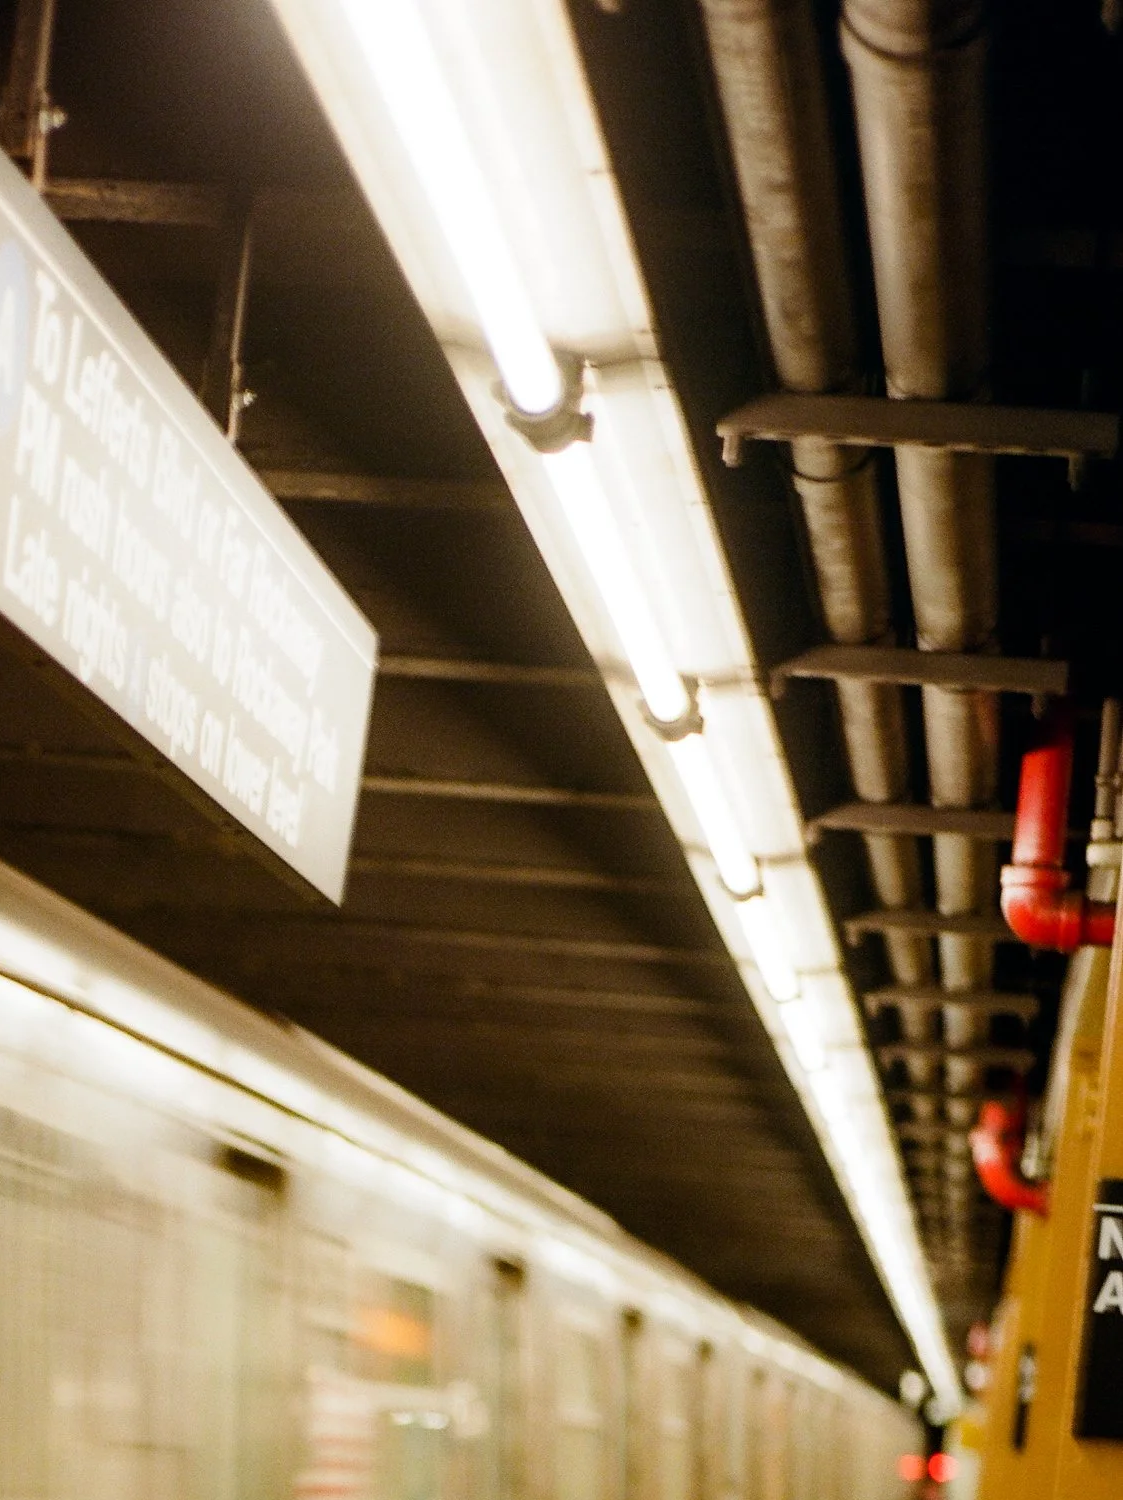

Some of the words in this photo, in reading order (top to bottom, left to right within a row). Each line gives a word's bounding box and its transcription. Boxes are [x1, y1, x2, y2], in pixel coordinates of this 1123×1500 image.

[15, 379, 62, 507] PM
[59, 454, 111, 562] rush
[112, 488, 172, 623] hours
[171, 568, 210, 664] also
[33, 268, 64, 386] To
[64, 313, 151, 491] Lefferts
[152, 421, 201, 541] Blvd
[3, 493, 61, 628] Late
[61, 564, 128, 692] nights
[145, 650, 198, 761] stops
[199, 709, 224, 779] on
[222, 713, 270, 817] lower
